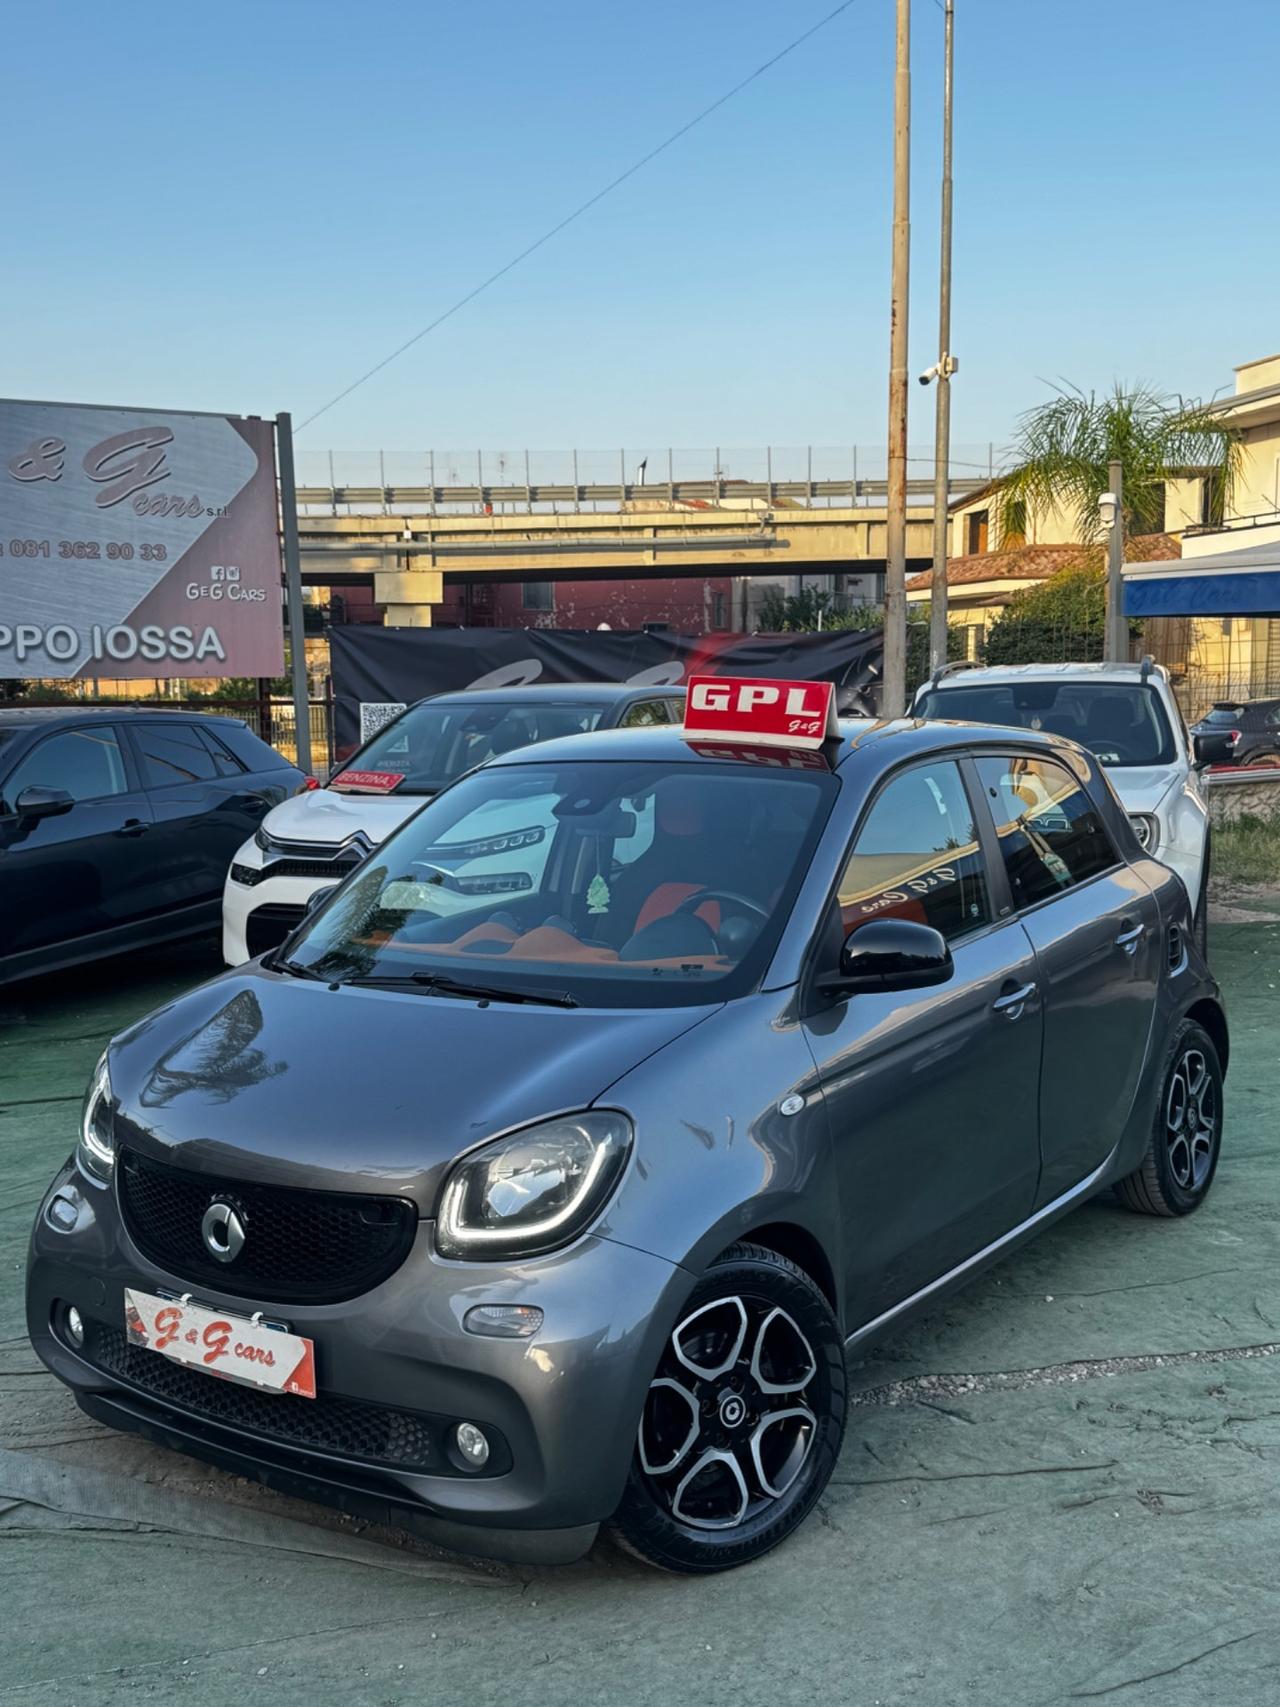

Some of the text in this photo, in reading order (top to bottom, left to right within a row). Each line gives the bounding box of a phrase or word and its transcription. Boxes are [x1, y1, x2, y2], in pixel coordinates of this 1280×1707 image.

[82, 426, 174, 507] G
[132, 493, 205, 518] cars
[9, 539, 168, 561] 081 362 90 33
[92, 624, 226, 661] IOSSA
[691, 684, 821, 717] GPL
[233, 1342, 276, 1368] cars
